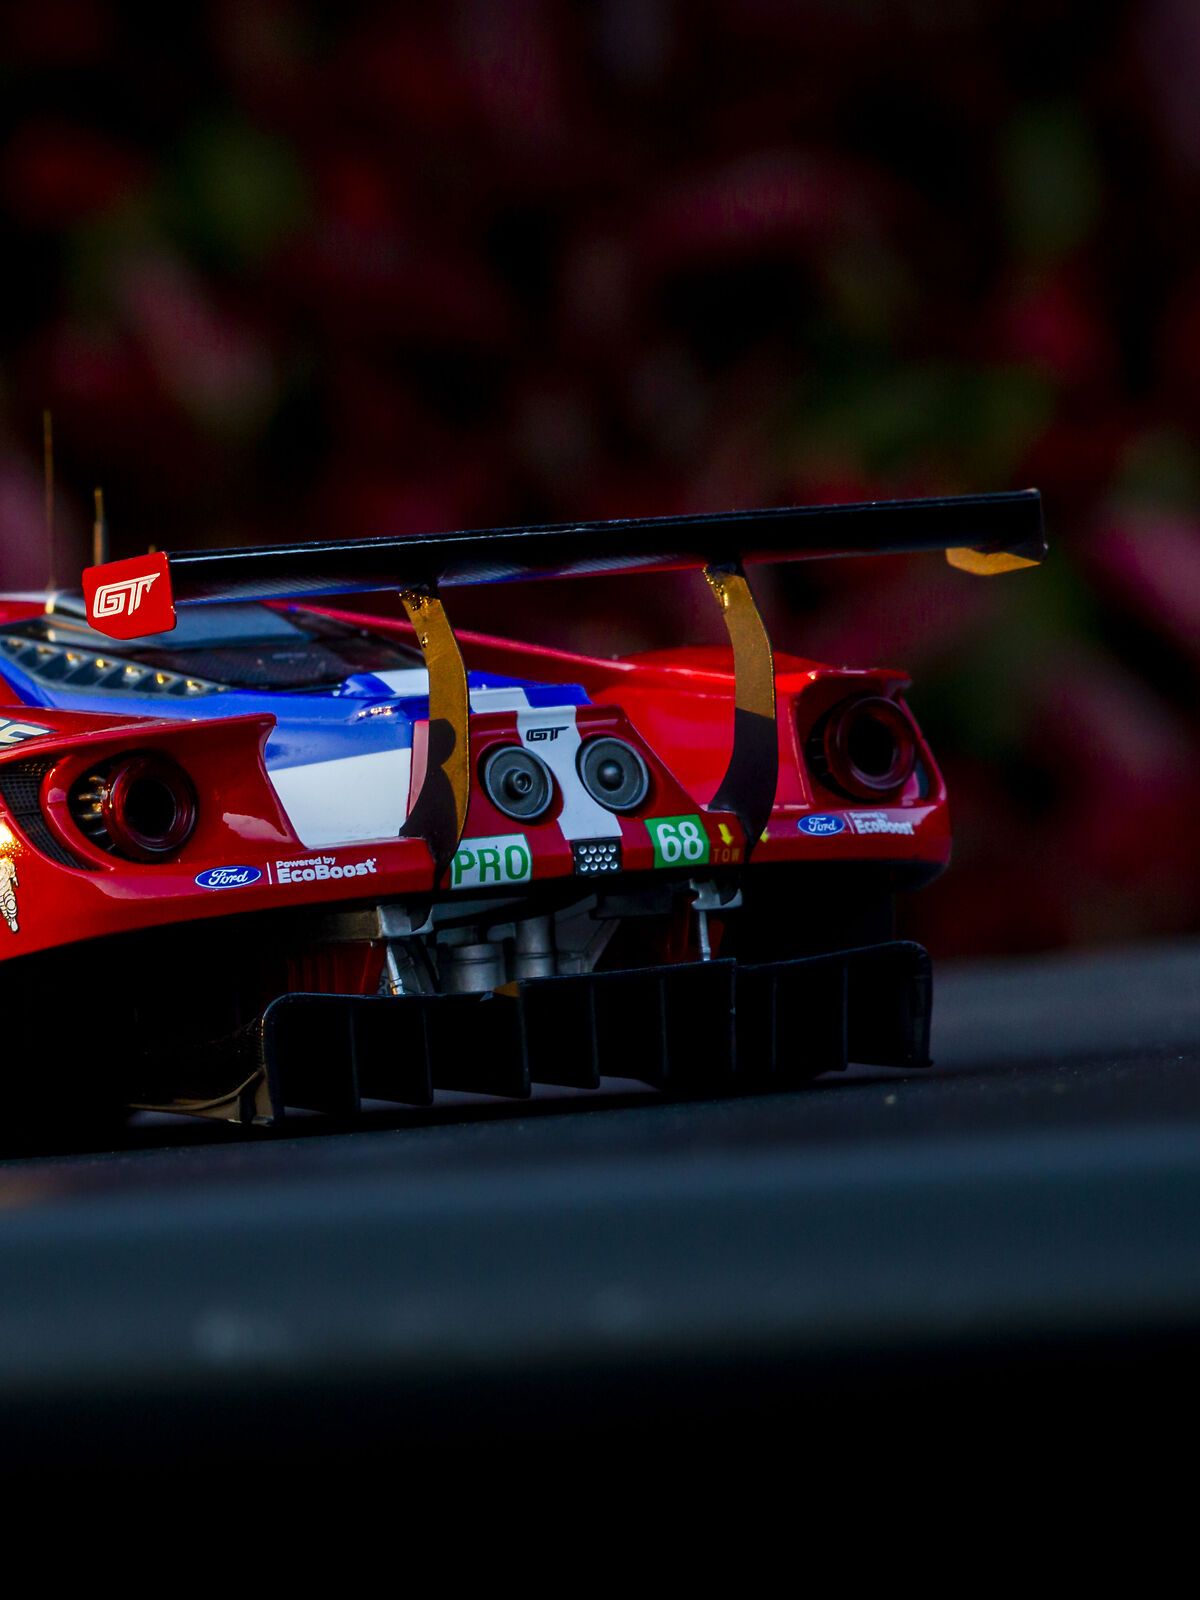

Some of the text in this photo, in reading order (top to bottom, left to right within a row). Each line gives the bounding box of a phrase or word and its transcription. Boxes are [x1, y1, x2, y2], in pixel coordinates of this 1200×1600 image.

[93, 572, 160, 618] GT
[526, 726, 569, 742] GT
[808, 817, 837, 832] Ford
[657, 822, 704, 862] 68
[276, 856, 336, 868] Powered by
[713, 848, 740, 863] TOW
[277, 858, 377, 884] EcoBoost
[454, 845, 529, 885] PRO
[208, 868, 249, 886] Ford
